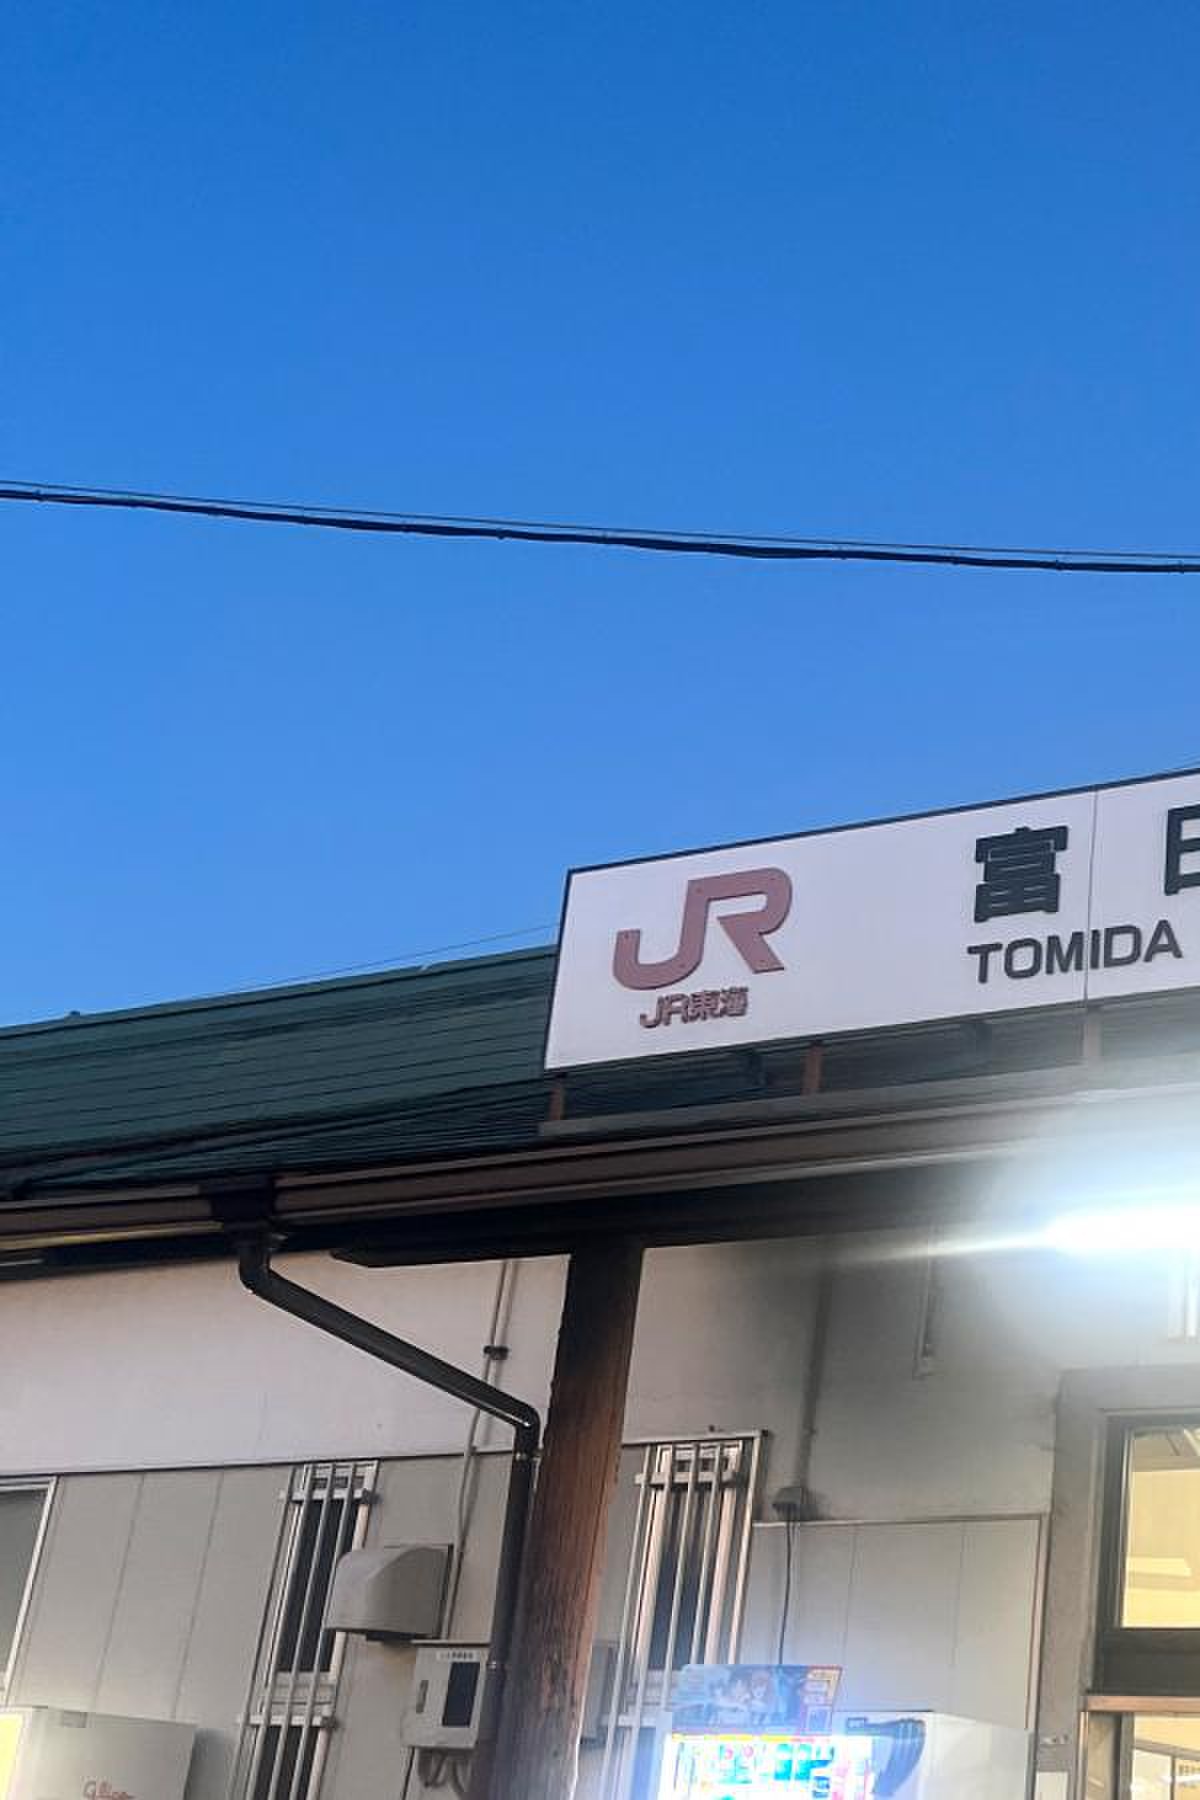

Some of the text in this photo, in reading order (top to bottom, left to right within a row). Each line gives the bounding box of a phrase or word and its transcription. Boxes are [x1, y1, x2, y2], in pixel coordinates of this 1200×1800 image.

[612, 867, 793, 991] JR
[967, 918, 1183, 984] TOMIDA
[639, 986, 749, 1028] JR東海
